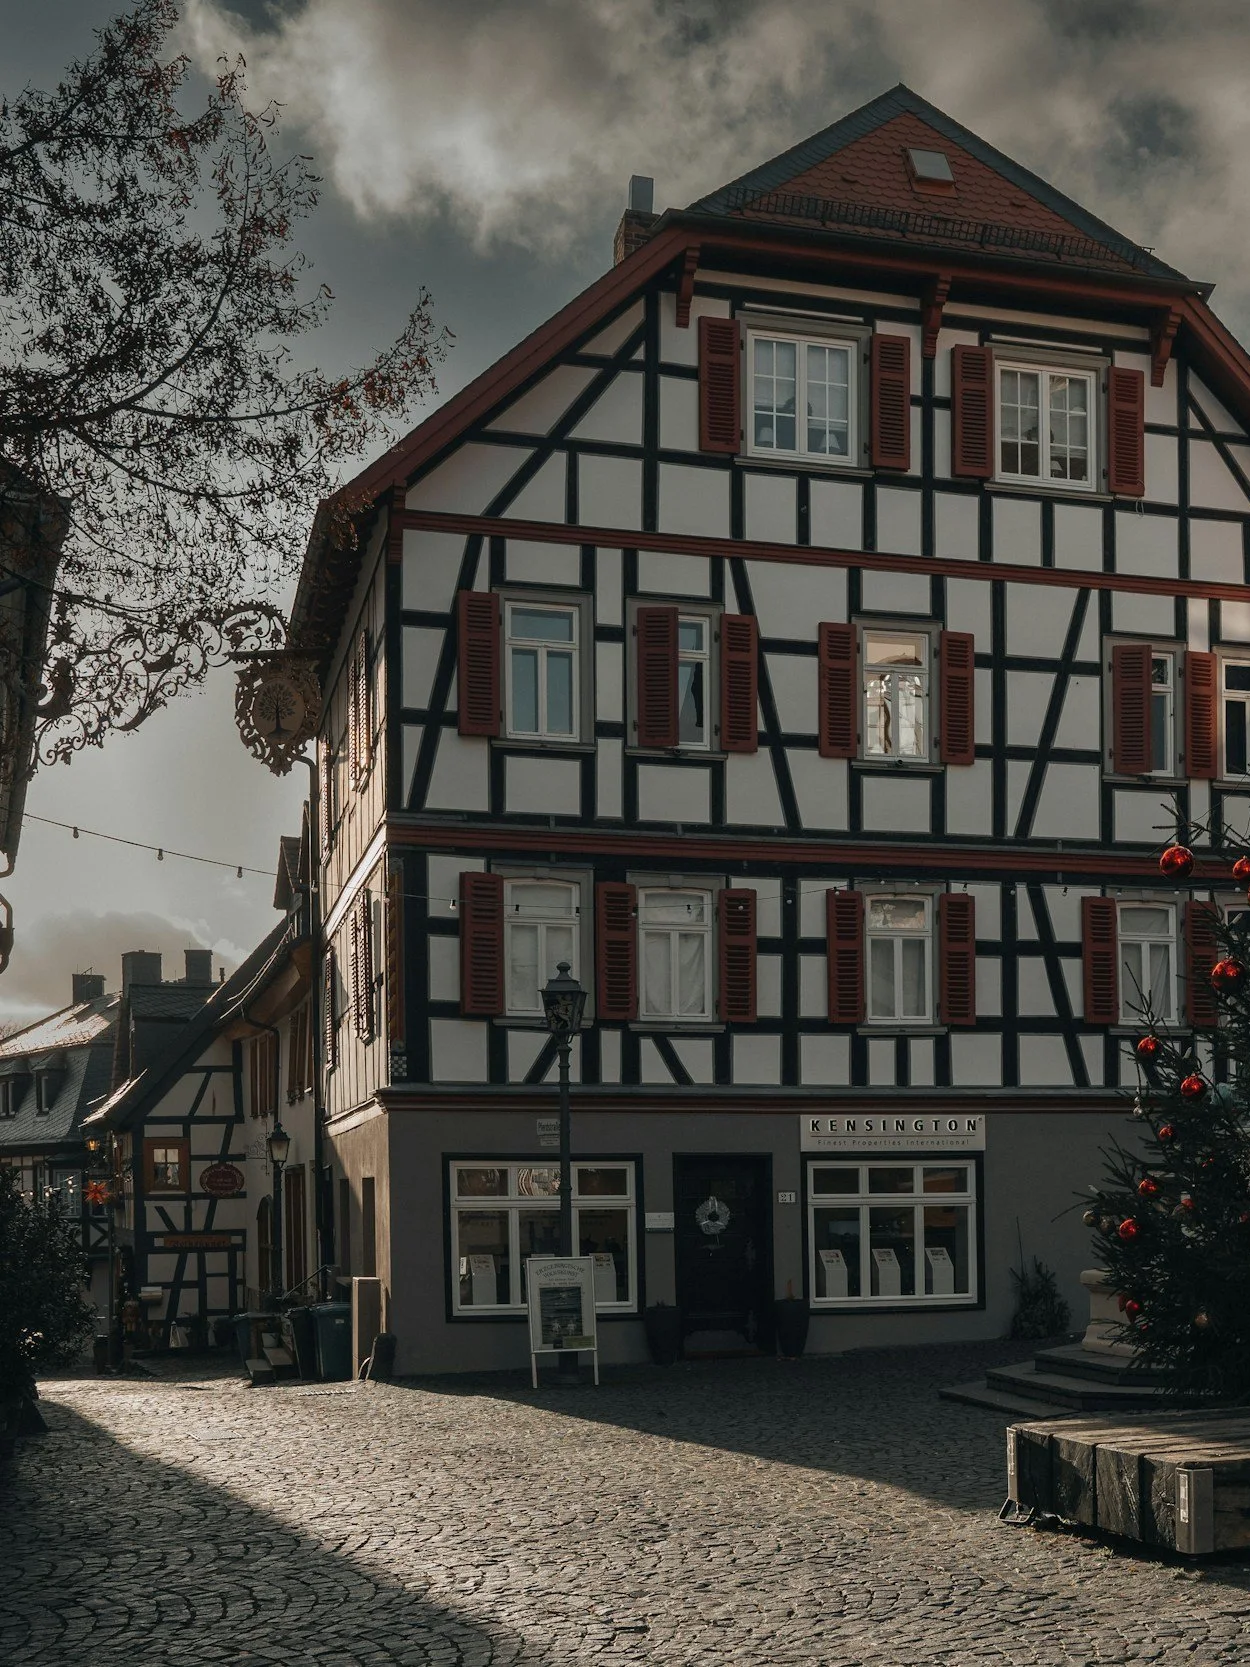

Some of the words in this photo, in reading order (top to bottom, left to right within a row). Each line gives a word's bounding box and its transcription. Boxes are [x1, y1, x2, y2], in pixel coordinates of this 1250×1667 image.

[810, 1119, 977, 1132] KENSINGTON
[818, 1138, 847, 1146] Finest
[852, 1138, 901, 1147] Properties
[906, 1138, 969, 1146] International
[780, 1193, 793, 1202] 21
